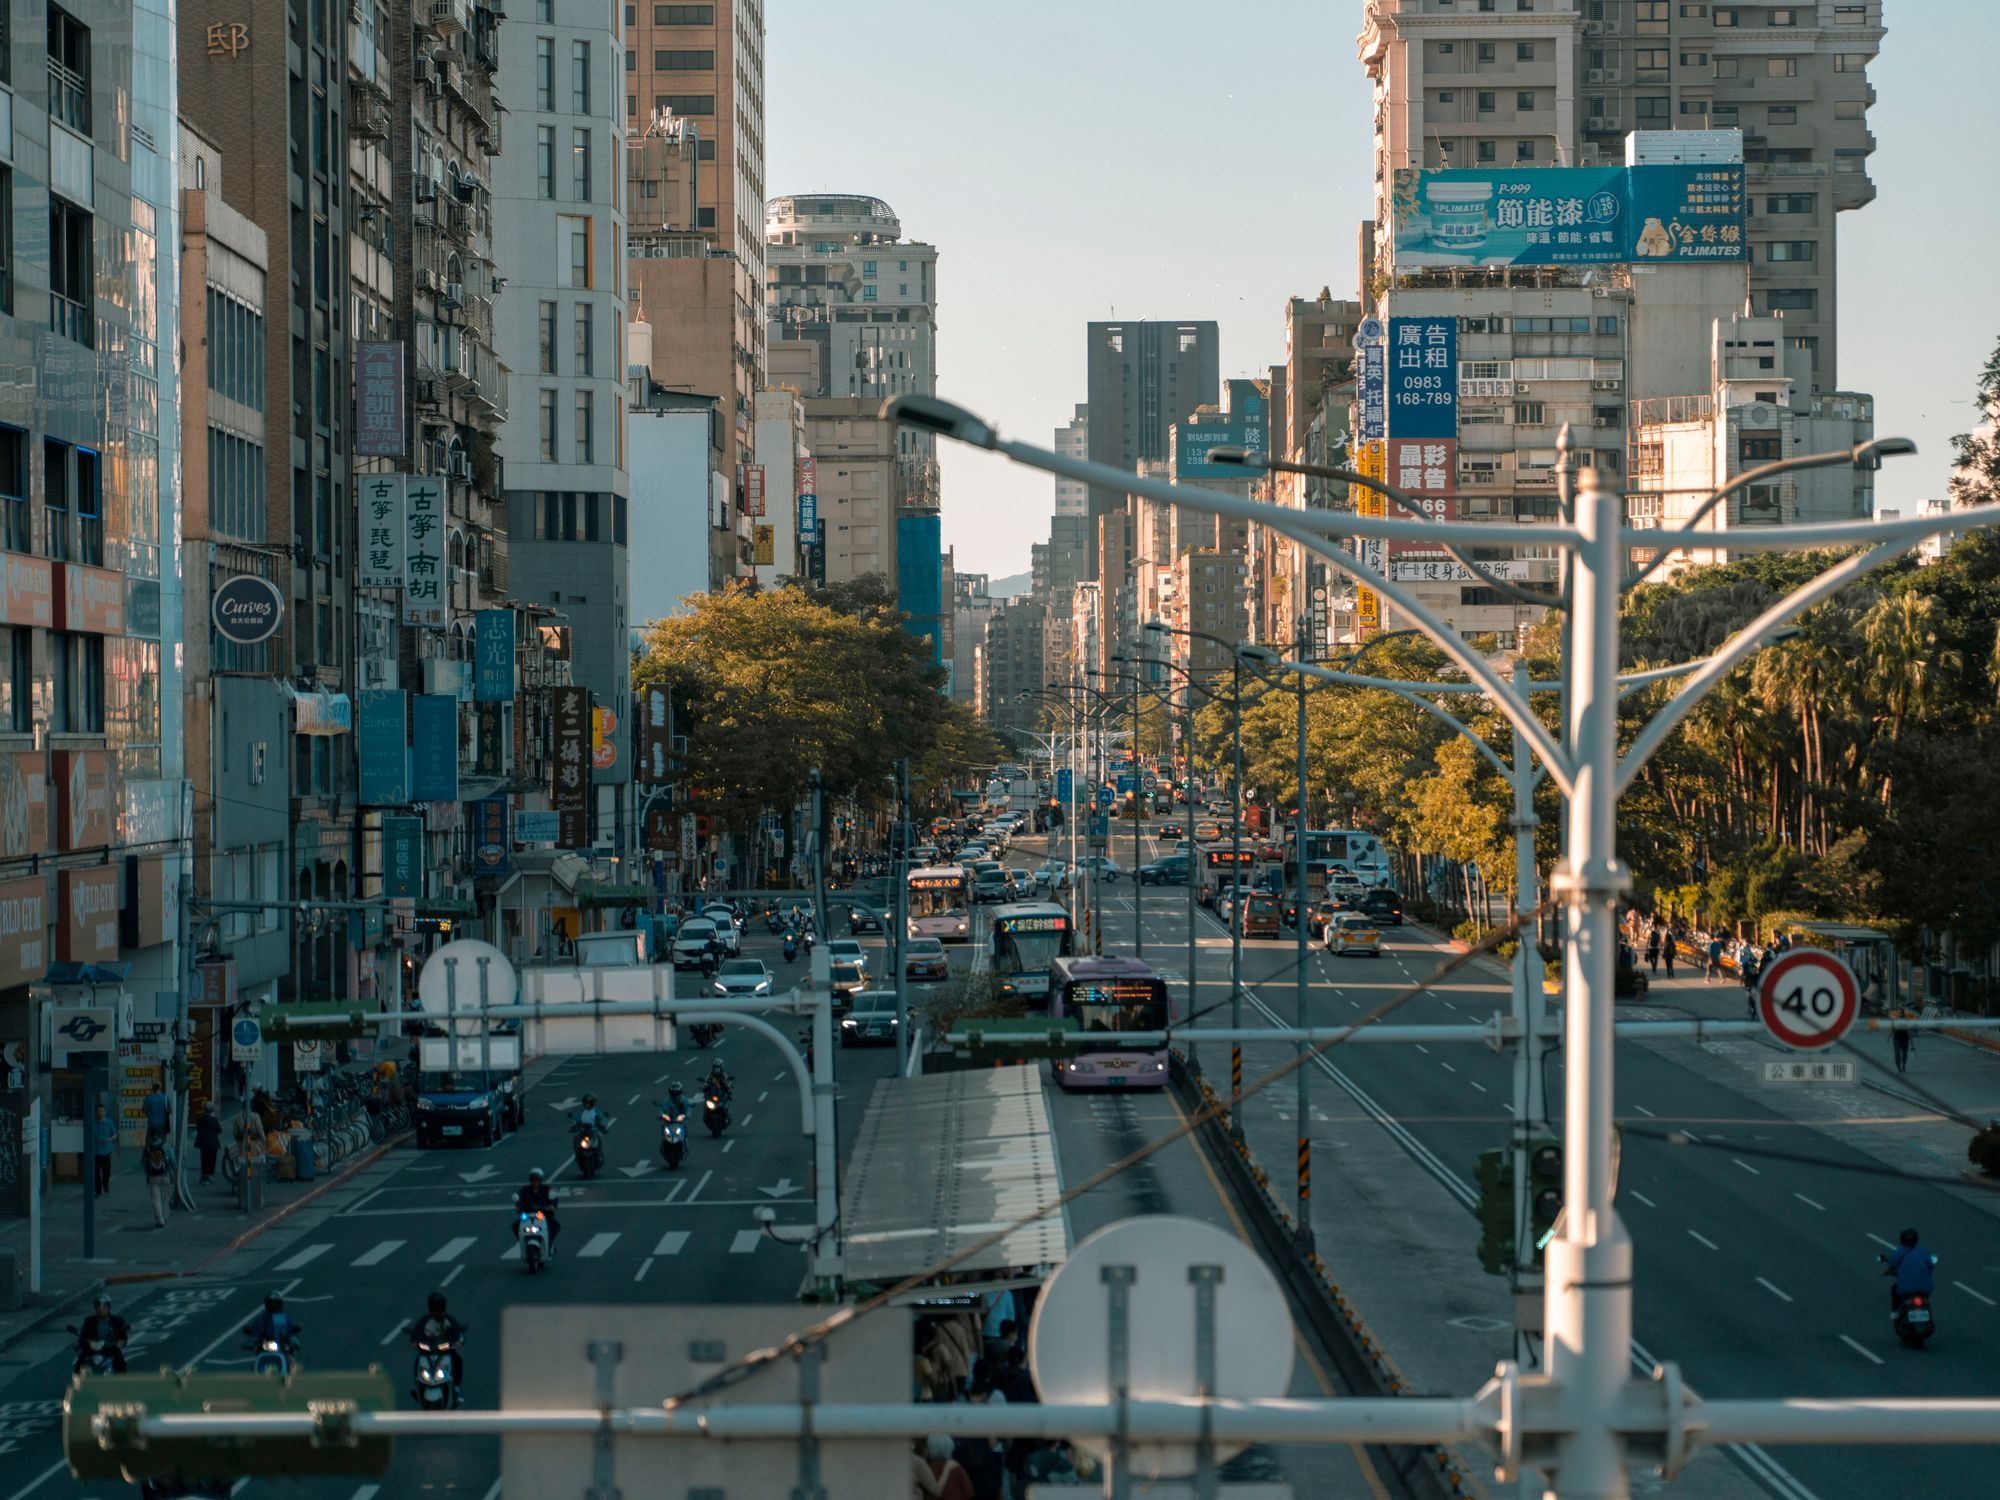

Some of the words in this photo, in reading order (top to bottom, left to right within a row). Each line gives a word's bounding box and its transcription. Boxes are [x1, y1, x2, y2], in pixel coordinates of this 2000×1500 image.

[206, 21, 250, 58] 邸
[1498, 183, 1532, 195] P-999
[1440, 203, 1486, 212] PLIMATES
[1496, 198, 1584, 227] 節能漆
[1679, 224, 1740, 242] 金絲猴
[1680, 245, 1741, 256] PLIMATES
[1398, 324, 1448, 346] 廣告
[1399, 347, 1449, 369] 出租
[364, 344, 396, 431] 汽車駕訓班
[1404, 376, 1442, 389] 0983
[1395, 392, 1452, 405] 168-789
[1187, 433, 1229, 442] 到站即到家
[1400, 445, 1447, 466] 晶彩
[1400, 468, 1447, 490] 廣告
[221, 598, 272, 616] Curves
[407, 609, 441, 624] 五樓
[483, 616, 507, 666] 志光
[483, 669, 507, 682] 數位
[363, 716, 401, 729] EUNICE
[101, 883, 115, 912] GYM
[1, 898, 20, 936] RLD
[22, 896, 41, 933] GYM
[552, 917, 568, 942] 4
[1781, 985, 1835, 1017] 40
[1769, 1064, 1848, 1080] 公車速限
